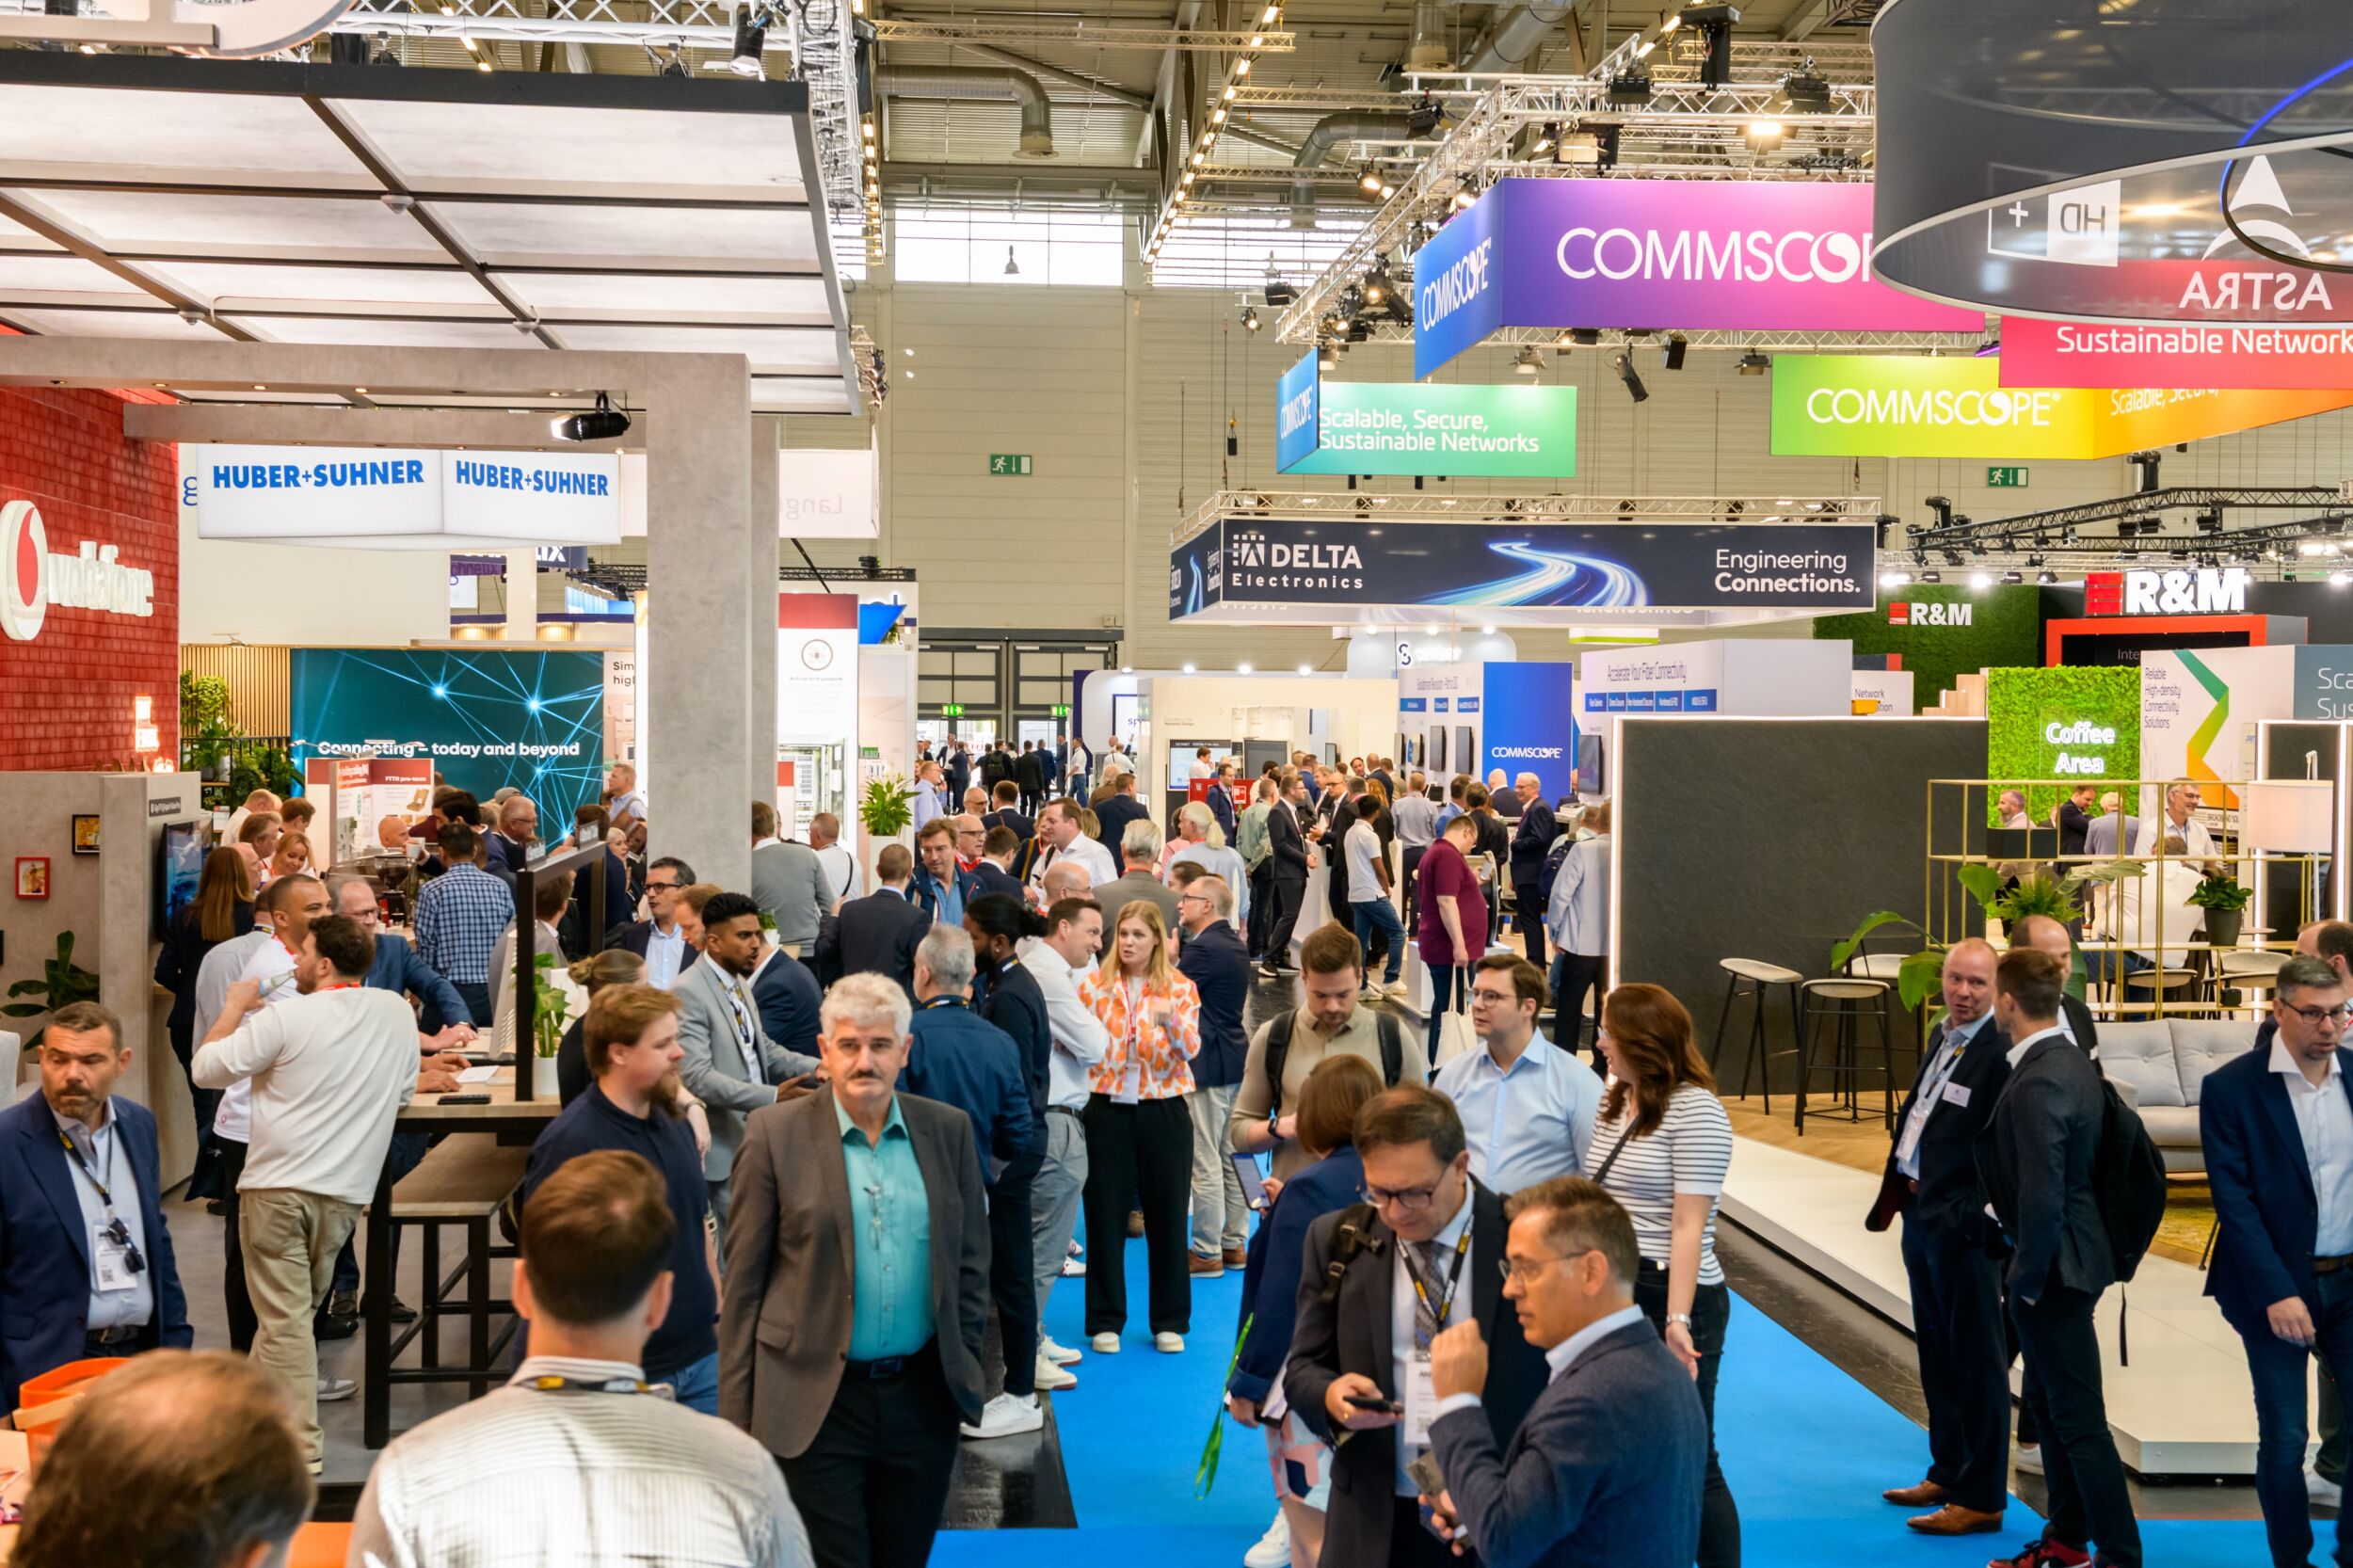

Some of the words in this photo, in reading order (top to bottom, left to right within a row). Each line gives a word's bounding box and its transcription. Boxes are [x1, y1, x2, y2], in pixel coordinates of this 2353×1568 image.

[2056, 326, 2223, 354] Sustainable
[1320, 408, 1408, 431] Scalable,
[1413, 408, 1489, 433] Secure,
[1320, 429, 1435, 452] Sustainable
[1441, 432, 1540, 453] Networks
[213, 459, 424, 488] HUBER+SUHNER
[456, 460, 609, 496] HUBER+SUHNER
[1272, 543, 1364, 569] DELTA
[1716, 548, 1848, 574] Engineering
[1232, 572, 1364, 589] Electronics
[1715, 572, 1861, 593] Connections.
[2126, 568, 2246, 613] R&M
[1911, 602, 1973, 626] R&M
[2145, 666, 2167, 680] Reliable
[1854, 688, 1885, 698] Network
[2144, 683, 2182, 699] High-density
[2144, 699, 2180, 715] Connectivity
[2045, 722, 2116, 744] Coffee
[2144, 715, 2170, 729] Solutions
[431, 742, 481, 759] today
[483, 742, 516, 756] and
[519, 742, 581, 759] beyond
[2054, 752, 2105, 775] Area
